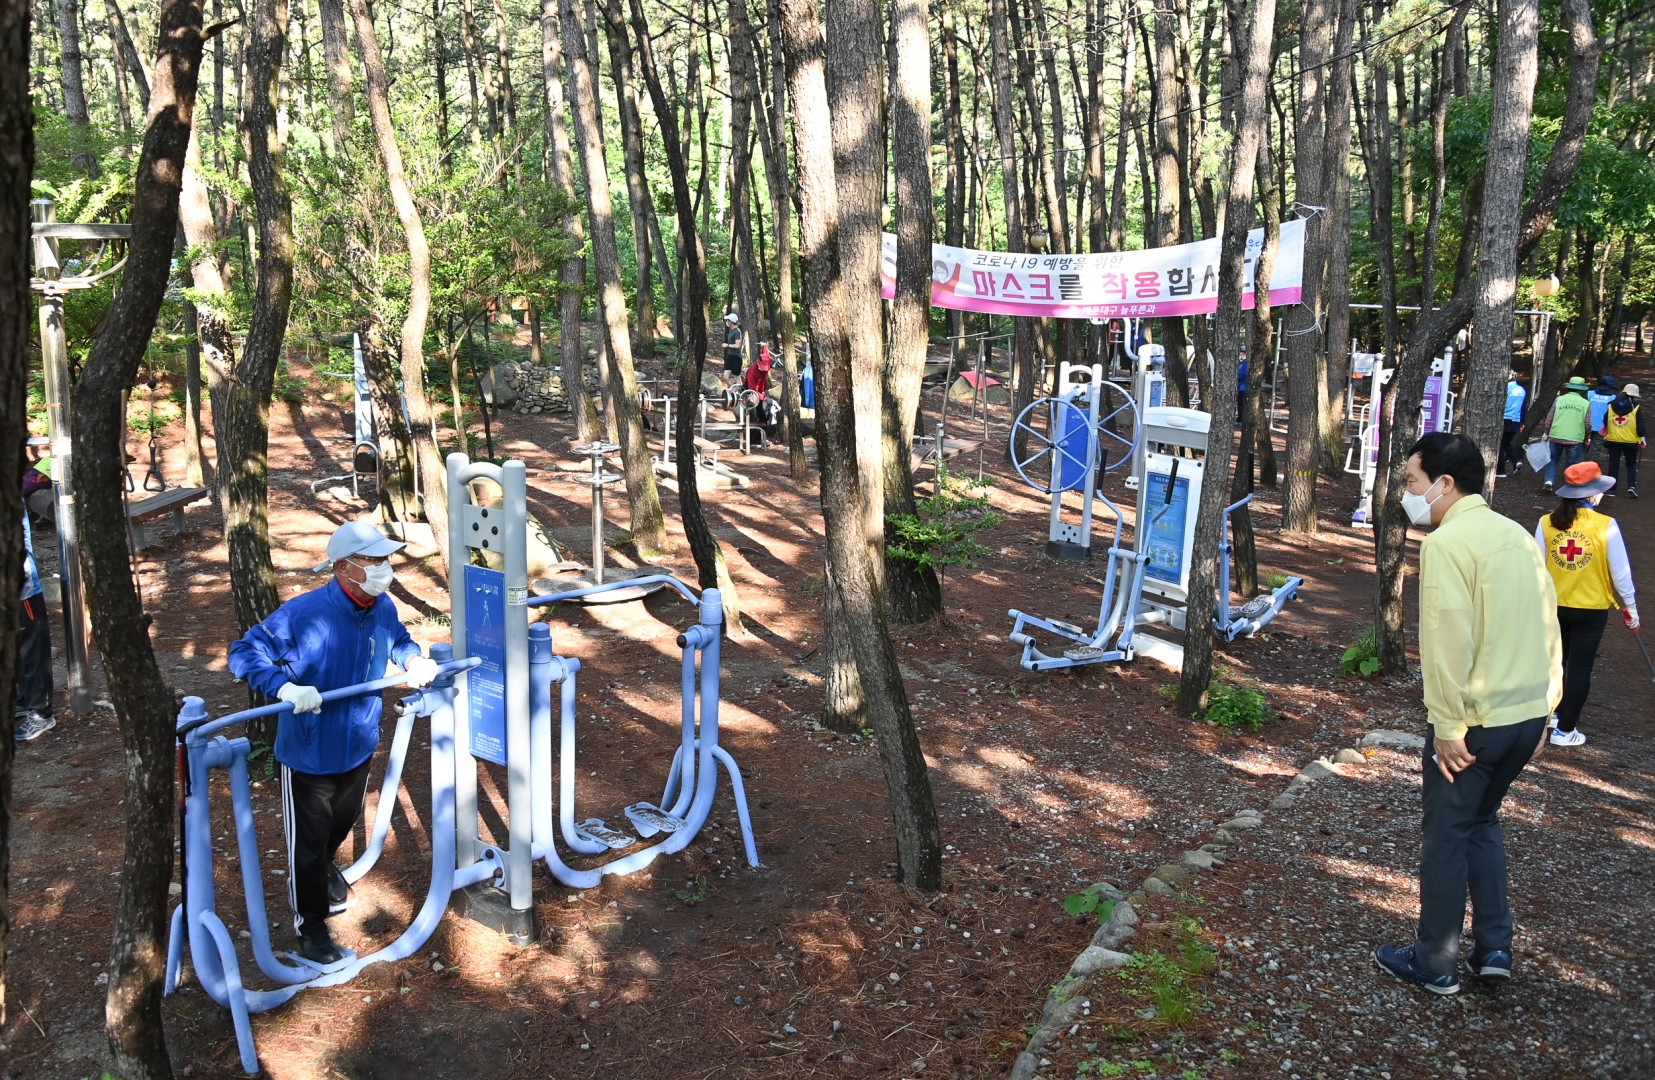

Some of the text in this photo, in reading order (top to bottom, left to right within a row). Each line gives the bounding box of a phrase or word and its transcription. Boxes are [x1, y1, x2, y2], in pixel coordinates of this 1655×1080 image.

[972, 253, 1124, 271] 코로나19 예방을 위한
[972, 257, 1260, 301] 마스크를 착용합시
[1120, 304, 1156, 315] 늘푸른과
[1566, 563, 1577, 571] RED
[1576, 552, 1593, 569] CROSS
